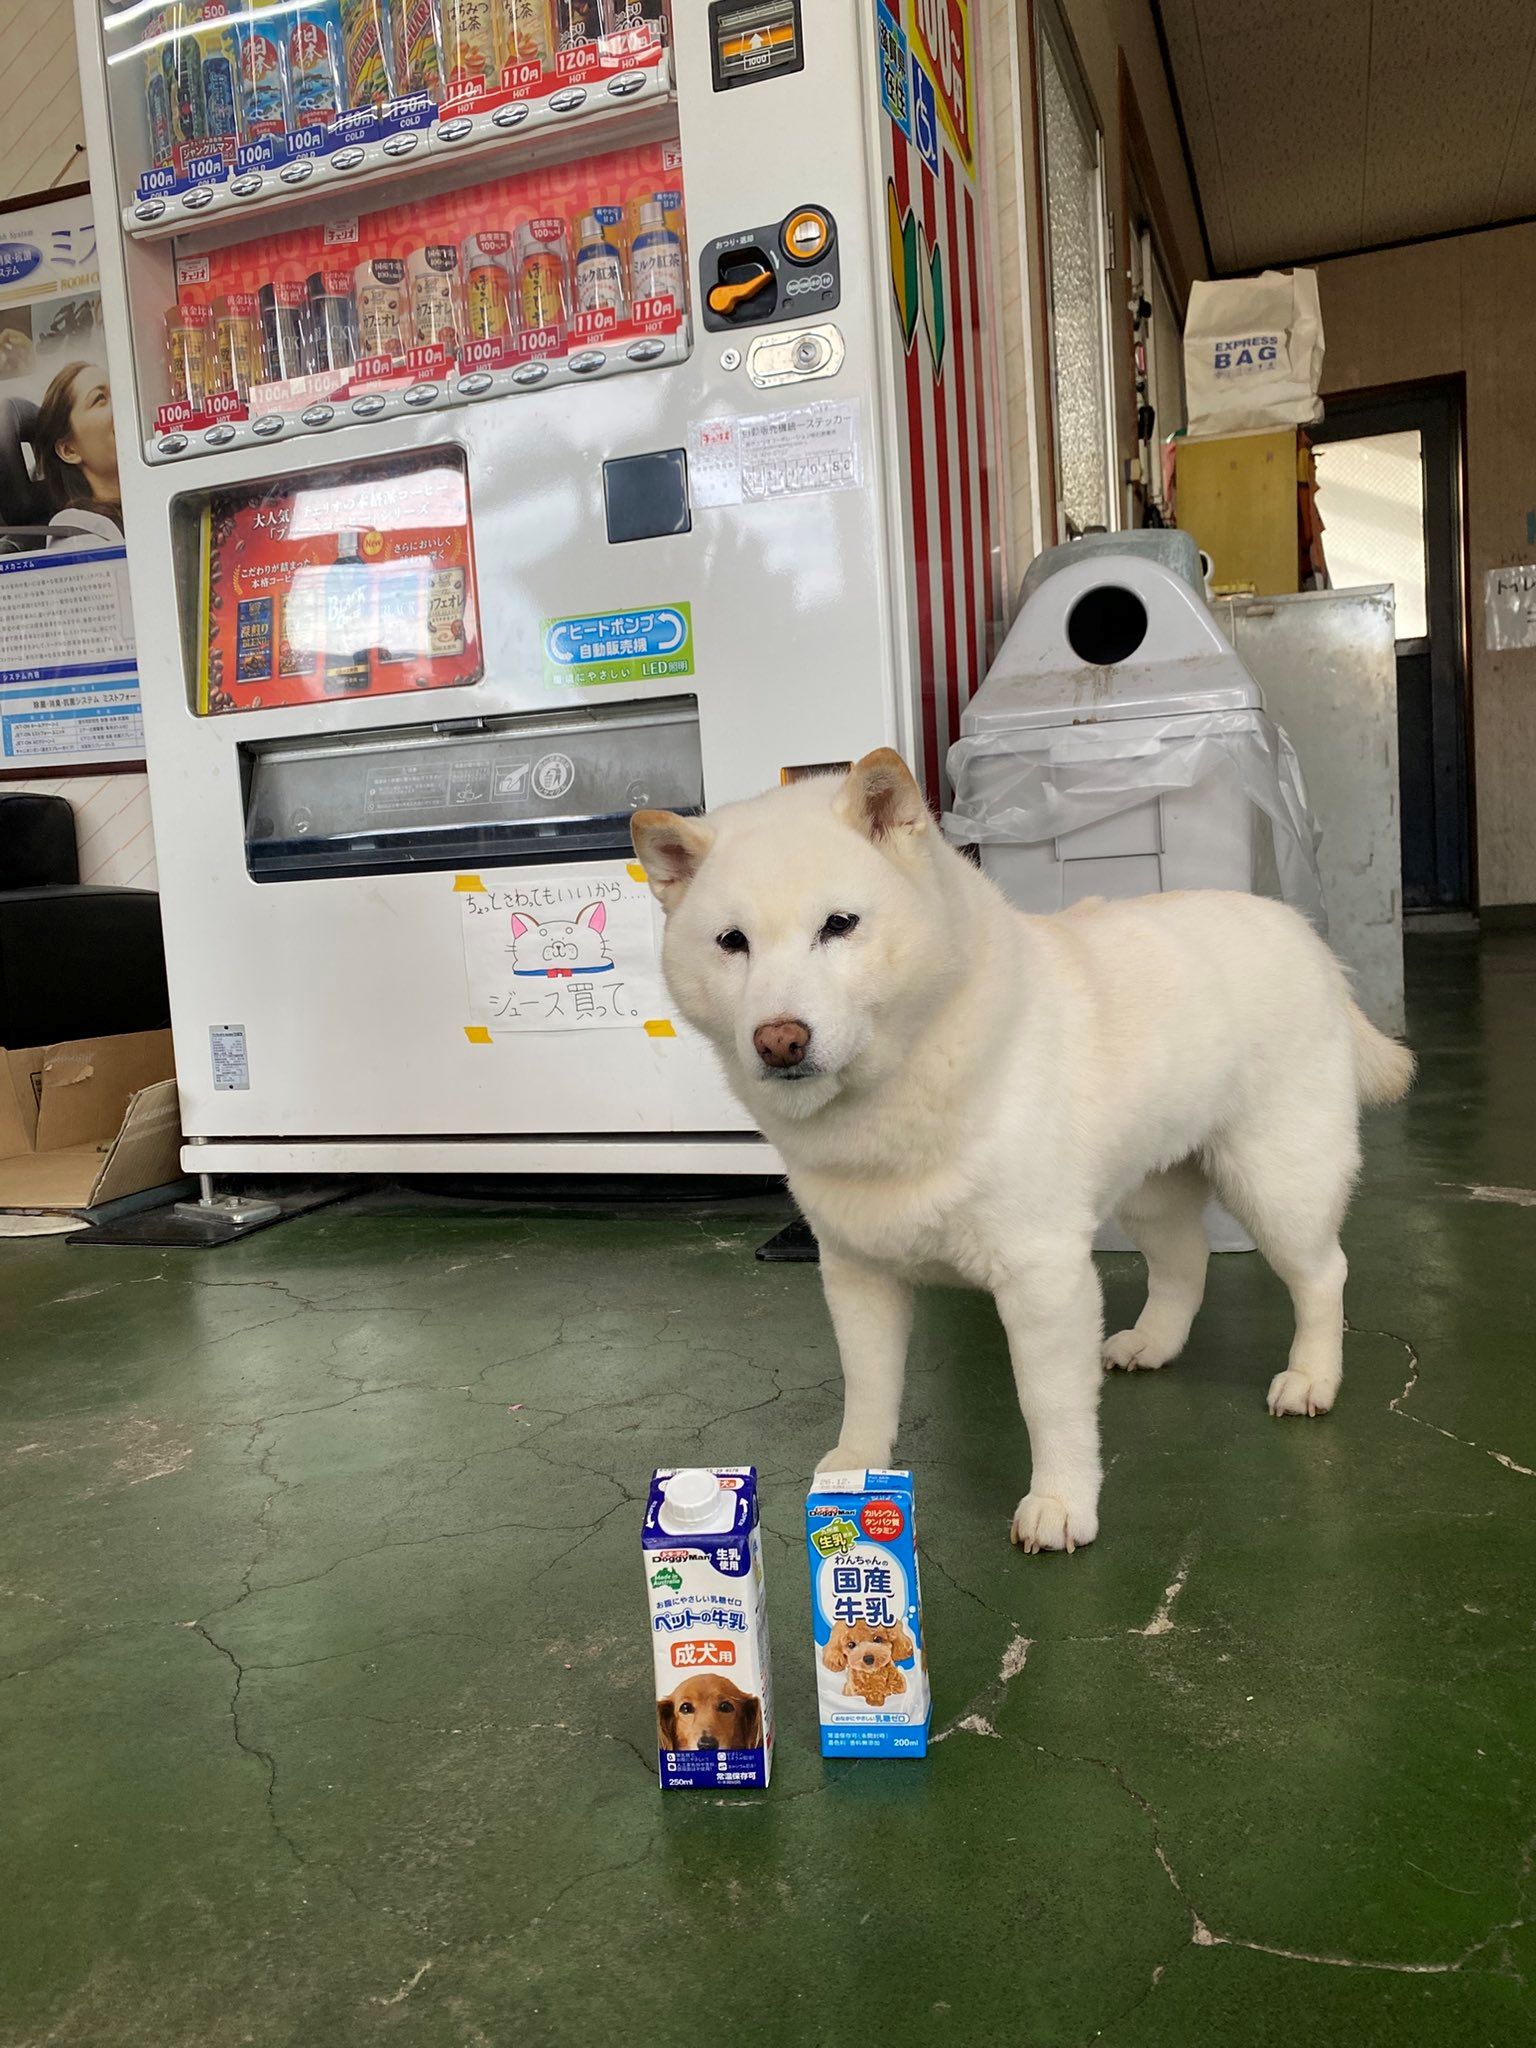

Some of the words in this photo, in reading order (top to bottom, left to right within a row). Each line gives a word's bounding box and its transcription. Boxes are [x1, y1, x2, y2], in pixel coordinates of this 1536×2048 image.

[204, 4, 225, 18] 500
[559, 50, 595, 72] 120円
[748, 55, 767, 66] 1000
[504, 66, 538, 88] 110円
[569, 72, 586, 84] HOT
[449, 81, 482, 103] 110円
[513, 87, 530, 99] HOT
[458, 102, 474, 113] HOT
[400, 116, 420, 128] COLD
[289, 131, 320, 150] 100円
[345, 130, 364, 142] COLD
[240, 145, 271, 165] 100円
[190, 160, 221, 178] 100円
[142, 171, 173, 190] 100円
[328, 229, 354, 241] チェリオ
[633, 253, 681, 274] ミルク紅茶
[181, 269, 206, 281] チェリオ
[635, 301, 672, 320] 110円
[578, 314, 613, 332] 110円
[645, 321, 663, 332] HOT
[521, 332, 556, 351] 100円
[587, 333, 604, 344] HOT
[1215, 337, 1278, 352] EXPRESS
[409, 349, 442, 367] 110円
[466, 343, 500, 362] 100円
[1215, 346, 1277, 369] BAG
[357, 361, 389, 378] 110円
[418, 369, 434, 378] HOT
[207, 396, 237, 414] 100円
[160, 405, 191, 424] 100円
[365, 538, 384, 548] New
[394, 536, 452, 554] さらにおいしく
[241, 558, 311, 578] こだわりが詰まった
[241, 623, 268, 638] 深煎り
[569, 614, 655, 640] ヒートポンプ
[580, 638, 648, 659] 自動販売機
[642, 660, 688, 675] LED照明
[489, 983, 638, 1020] ジュース買って。
[864, 1510, 899, 1518] カルシウム
[865, 1518, 900, 1527] タンパク質
[869, 1527, 897, 1535] ビタミン
[819, 1533, 847, 1549] 生乳
[652, 1554, 710, 1563] DoggyMan
[716, 1548, 740, 1560] 生乳
[834, 1555, 888, 1567] わんちゃんの
[719, 1561, 739, 1571] 使用
[654, 1578, 681, 1587] Australia
[834, 1567, 892, 1594] 国産
[656, 1595, 742, 1609] お腹にやさしい乳糖ゼロ
[834, 1598, 894, 1625] 牛乳
[654, 1609, 747, 1631] ペットの牛乳
[675, 1642, 733, 1665] 成犬用
[894, 1739, 918, 1747] 200ml
[716, 1772, 756, 1780] 常温保存可
